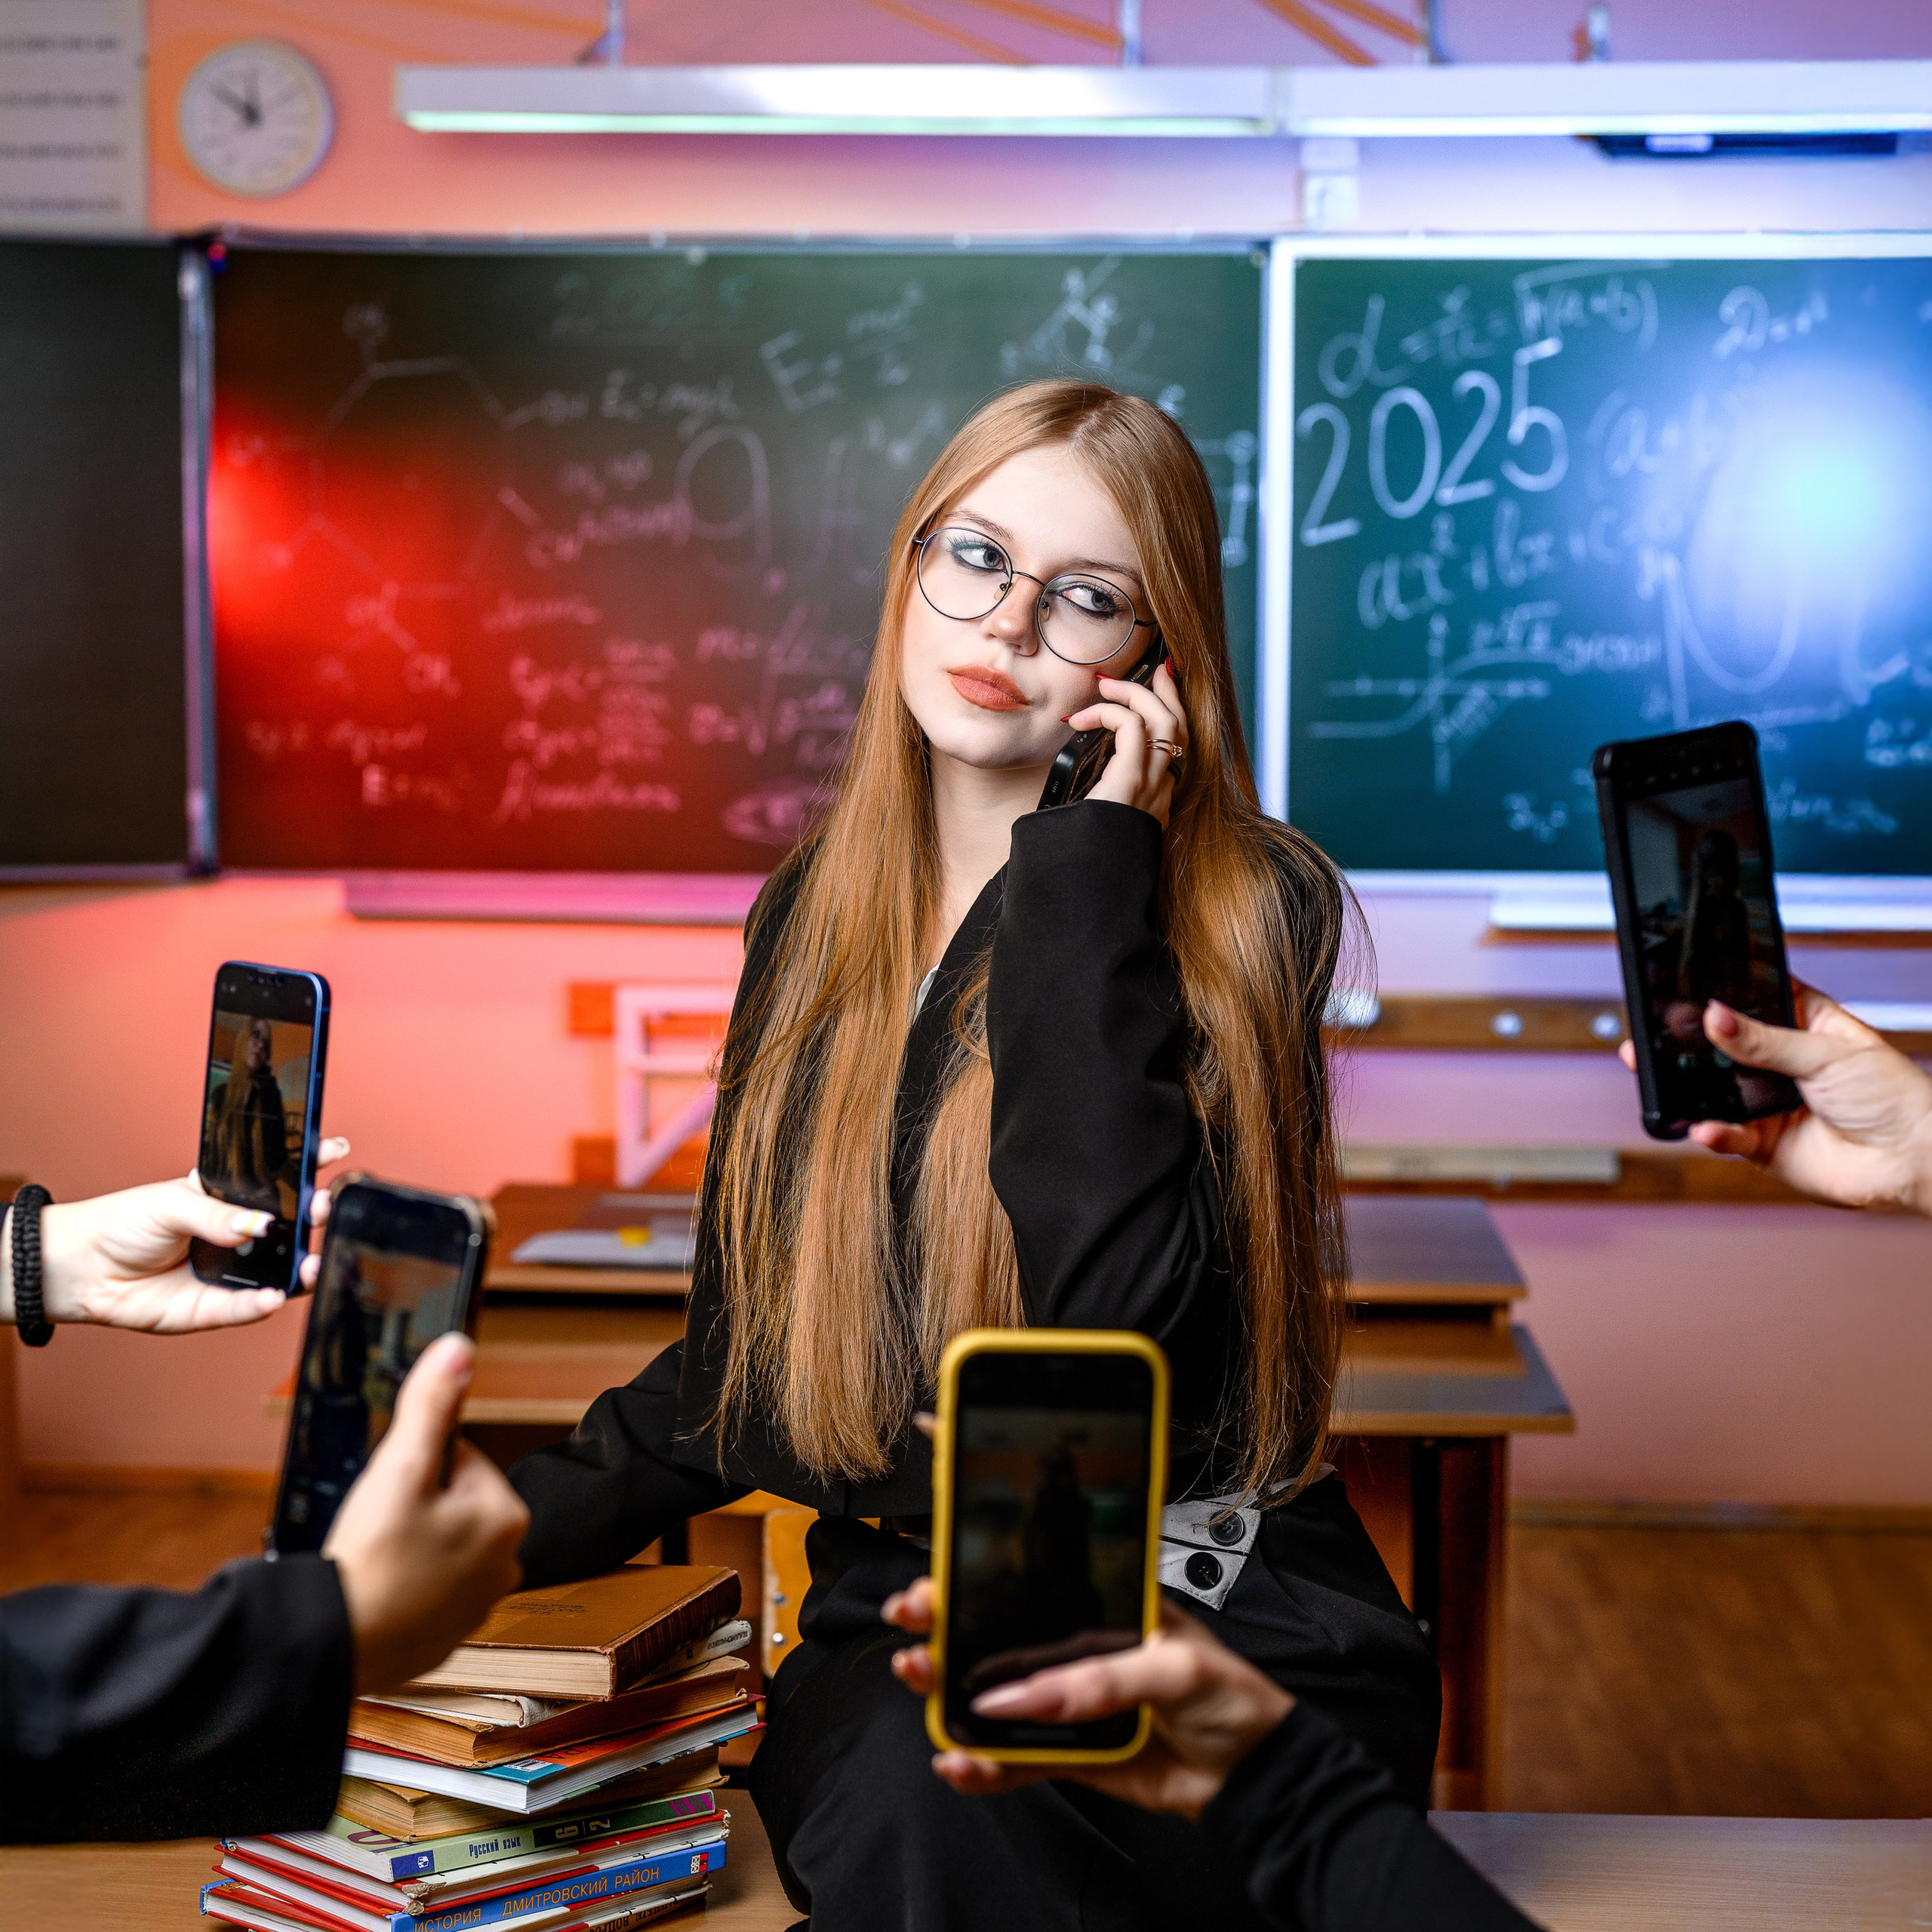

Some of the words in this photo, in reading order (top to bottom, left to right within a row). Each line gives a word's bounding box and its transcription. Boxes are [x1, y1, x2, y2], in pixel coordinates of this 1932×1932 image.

[1295, 336, 1570, 548] 2025
[469, 1838, 499, 1859] Русский
[503, 1836, 521, 1849] язык
[414, 1908, 482, 1932] ИСТОРИЯ
[502, 1876, 608, 1917] ДМИТРОВСКИЙ
[615, 1866, 660, 1888] РАЙОН
